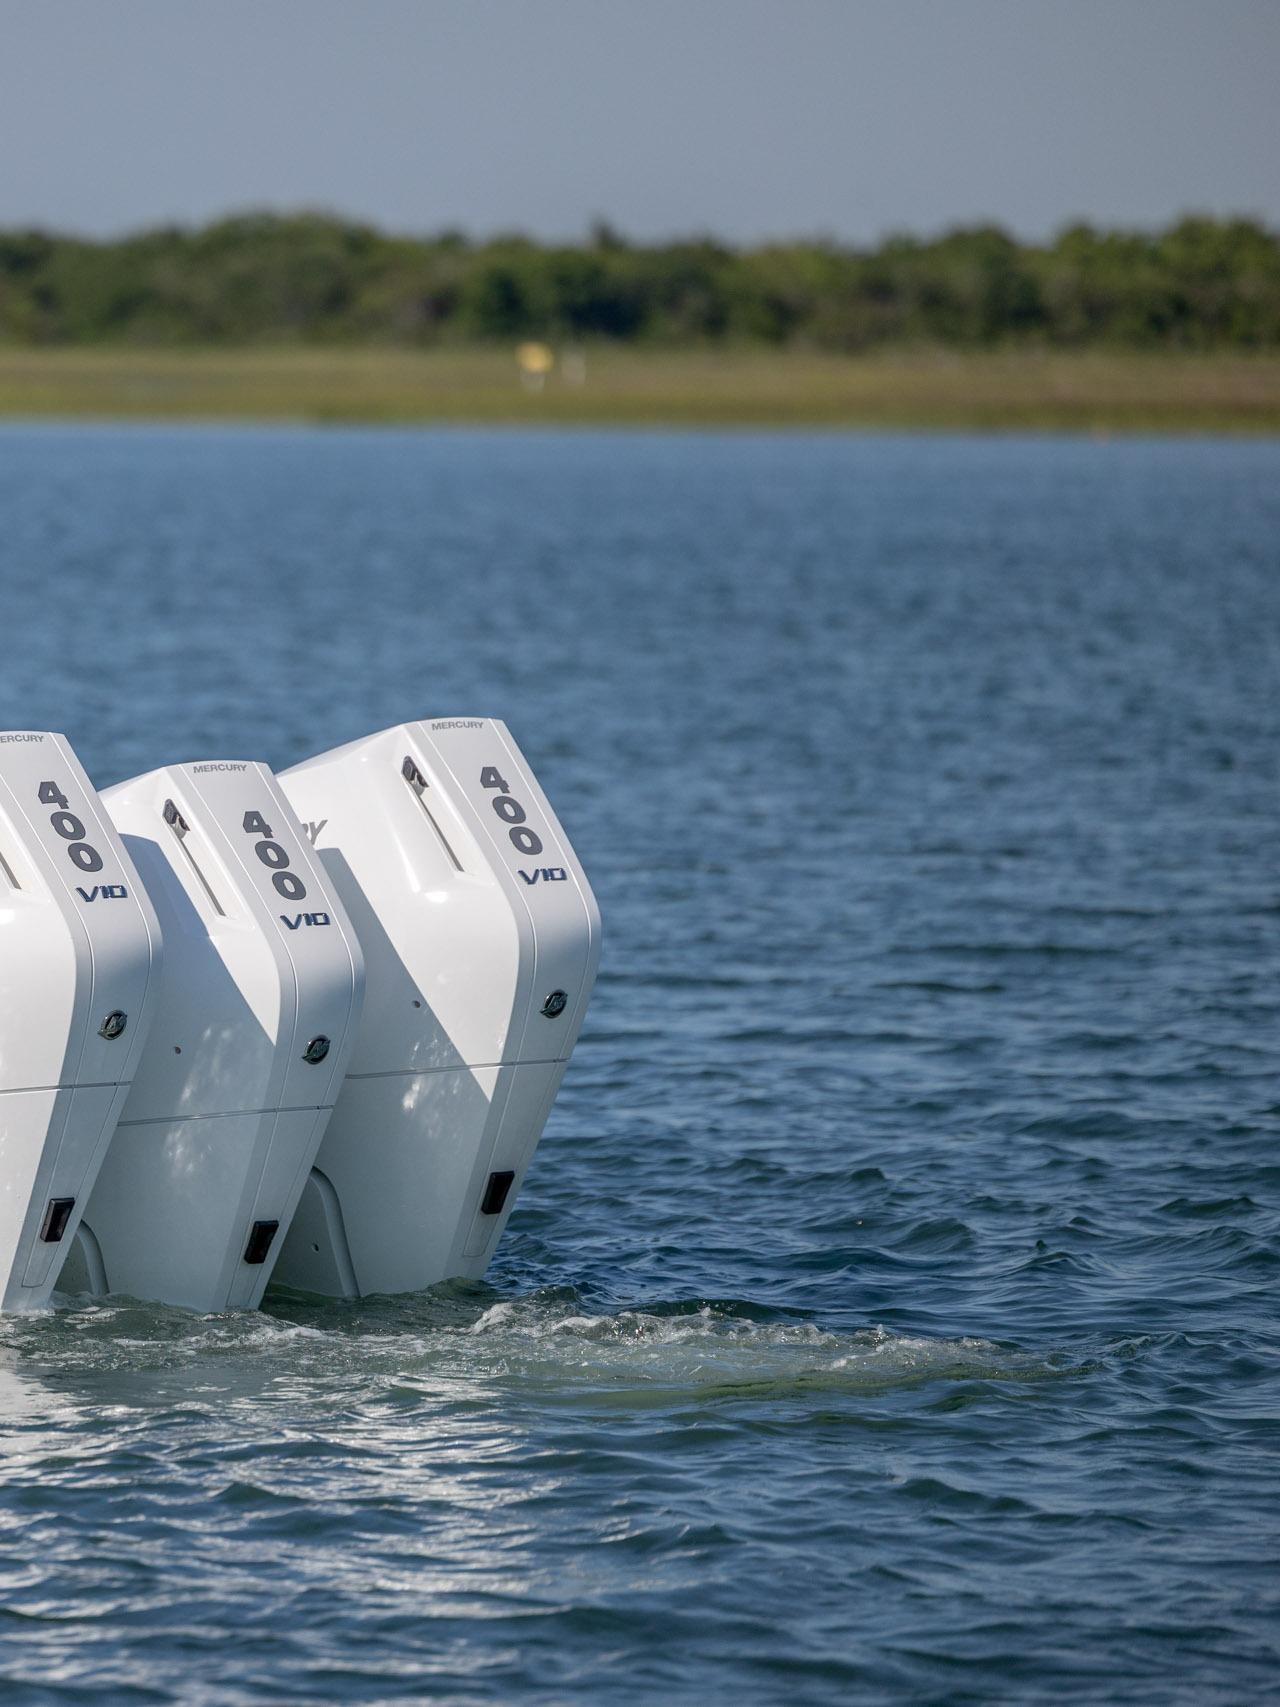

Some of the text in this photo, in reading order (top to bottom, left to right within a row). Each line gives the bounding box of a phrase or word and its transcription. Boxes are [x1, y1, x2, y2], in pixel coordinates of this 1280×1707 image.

[431, 720, 484, 731] MERCURY
[193, 763, 247, 774] MERCURY
[480, 766, 543, 856] 400
[37, 780, 104, 873] 400
[242, 810, 307, 901] 400
[518, 867, 568, 886] V10
[76, 884, 129, 903] V10
[280, 912, 332, 930] V10
